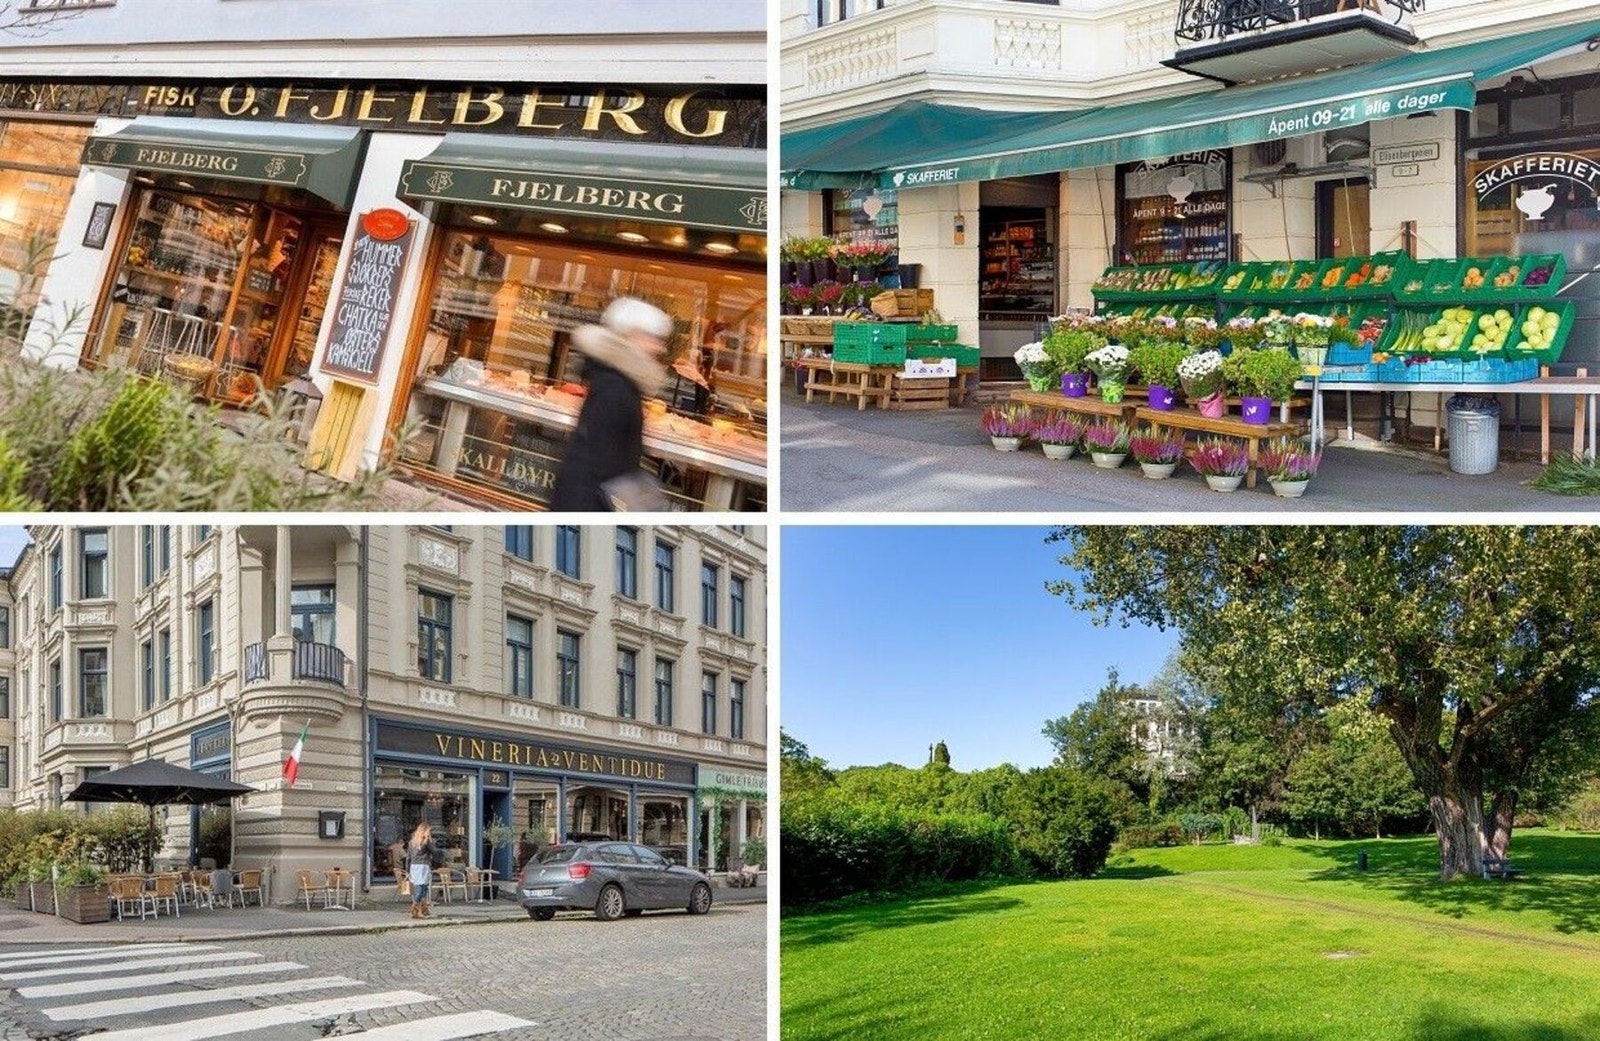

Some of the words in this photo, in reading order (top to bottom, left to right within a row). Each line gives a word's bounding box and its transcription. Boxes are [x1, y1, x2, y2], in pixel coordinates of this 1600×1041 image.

[143, 84, 200, 107] FISK
[274, 83, 729, 139] FJELBERG
[1268, 115, 1310, 135] Åpent
[1312, 104, 1355, 126] 09-21
[1365, 99, 1391, 116] alle
[1397, 90, 1447, 111] dager
[137, 148, 239, 173] FJELBERG
[1475, 156, 1600, 194] SKAFFERIET
[906, 168, 960, 186] SKAFFERIET
[491, 178, 686, 216] FJELBERG
[359, 283, 392, 312] REKER
[337, 302, 379, 334] CHATKA
[435, 734, 549, 767] VINERIA
[563, 750, 666, 780] VENTIDUE
[491, 773, 501, 783] 22
[715, 773, 742, 787] GIMLE
